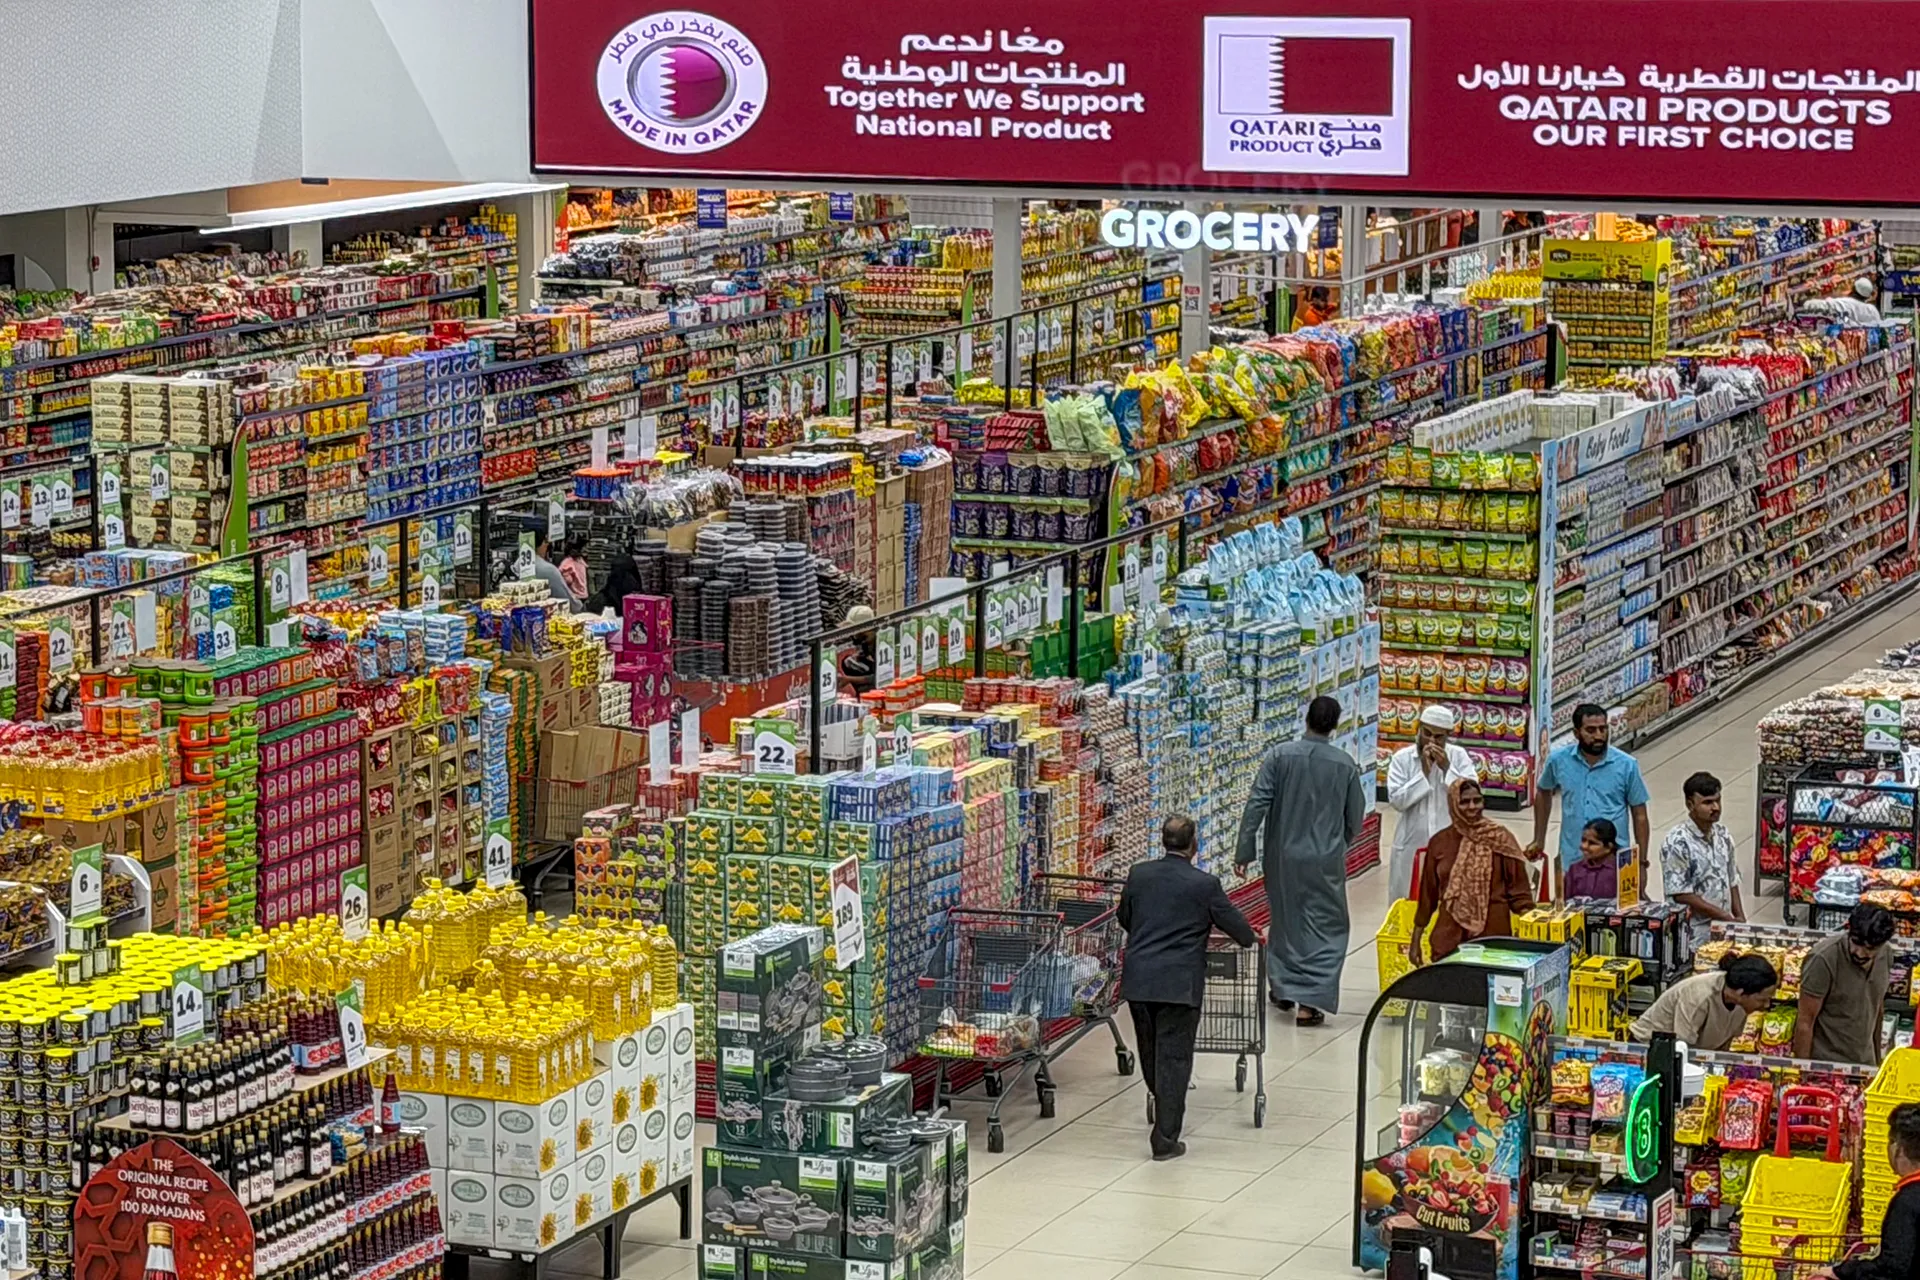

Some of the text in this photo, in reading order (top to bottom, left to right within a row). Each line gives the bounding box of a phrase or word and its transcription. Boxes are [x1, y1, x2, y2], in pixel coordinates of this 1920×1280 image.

[609, 18, 754, 66] صنع بفخر في قطر
[900, 29, 993, 55] ندعم
[841, 55, 1126, 89] المنتجات الوطنية
[1457, 60, 1529, 90] الأول
[1537, 63, 1626, 92] خيارنا
[1638, 63, 1766, 93] القطرية
[824, 85, 1146, 115] Together We Support
[1500, 95, 1892, 125] QATARI PRODUCTS
[608, 98, 757, 146] MADE IN QATAR
[855, 114, 1112, 141] National Product
[1229, 119, 1315, 136] QATARI
[1229, 140, 1315, 153] PRODUCT
[1532, 123, 1854, 151] OUR FIRST CHOICE
[1101, 208, 1320, 253] GROCERY
[1585, 423, 1631, 461] Baby Foods
[104, 480, 115, 493] 19
[152, 471, 164, 487] 10
[34, 491, 48, 505] 13
[55, 488, 67, 501] 12
[3, 498, 15, 512] 14
[106, 522, 118, 535] 75
[456, 531, 466, 547] 11
[371, 554, 382, 572] 14
[520, 550, 532, 567] 39
[1126, 563, 1136, 579] 13
[275, 574, 283, 594] 8
[424, 586, 435, 601] 52
[113, 621, 127, 640] 21
[216, 630, 230, 650] 33
[950, 629, 961, 646] 10
[52, 638, 66, 657] 22
[903, 644, 912, 658] 11
[924, 633, 935, 650] 10
[878, 648, 889, 666] 11
[822, 672, 832, 688] 25
[1873, 708, 1881, 718] 6
[1874, 731, 1881, 741] 3
[759, 745, 786, 763] 22
[896, 736, 908, 756] 13
[488, 845, 505, 867] 41
[79, 874, 88, 893] 6
[344, 895, 362, 919] 26
[176, 990, 195, 1017] 14
[347, 1021, 356, 1043] 9
[152, 1158, 174, 1172] THE
[117, 1169, 209, 1192] ORIGINAL RECIPE
[135, 1186, 191, 1205] FOR OVER
[120, 1200, 206, 1222] 100 RAMADANS
[1416, 1204, 1471, 1232] Cut Fruits
